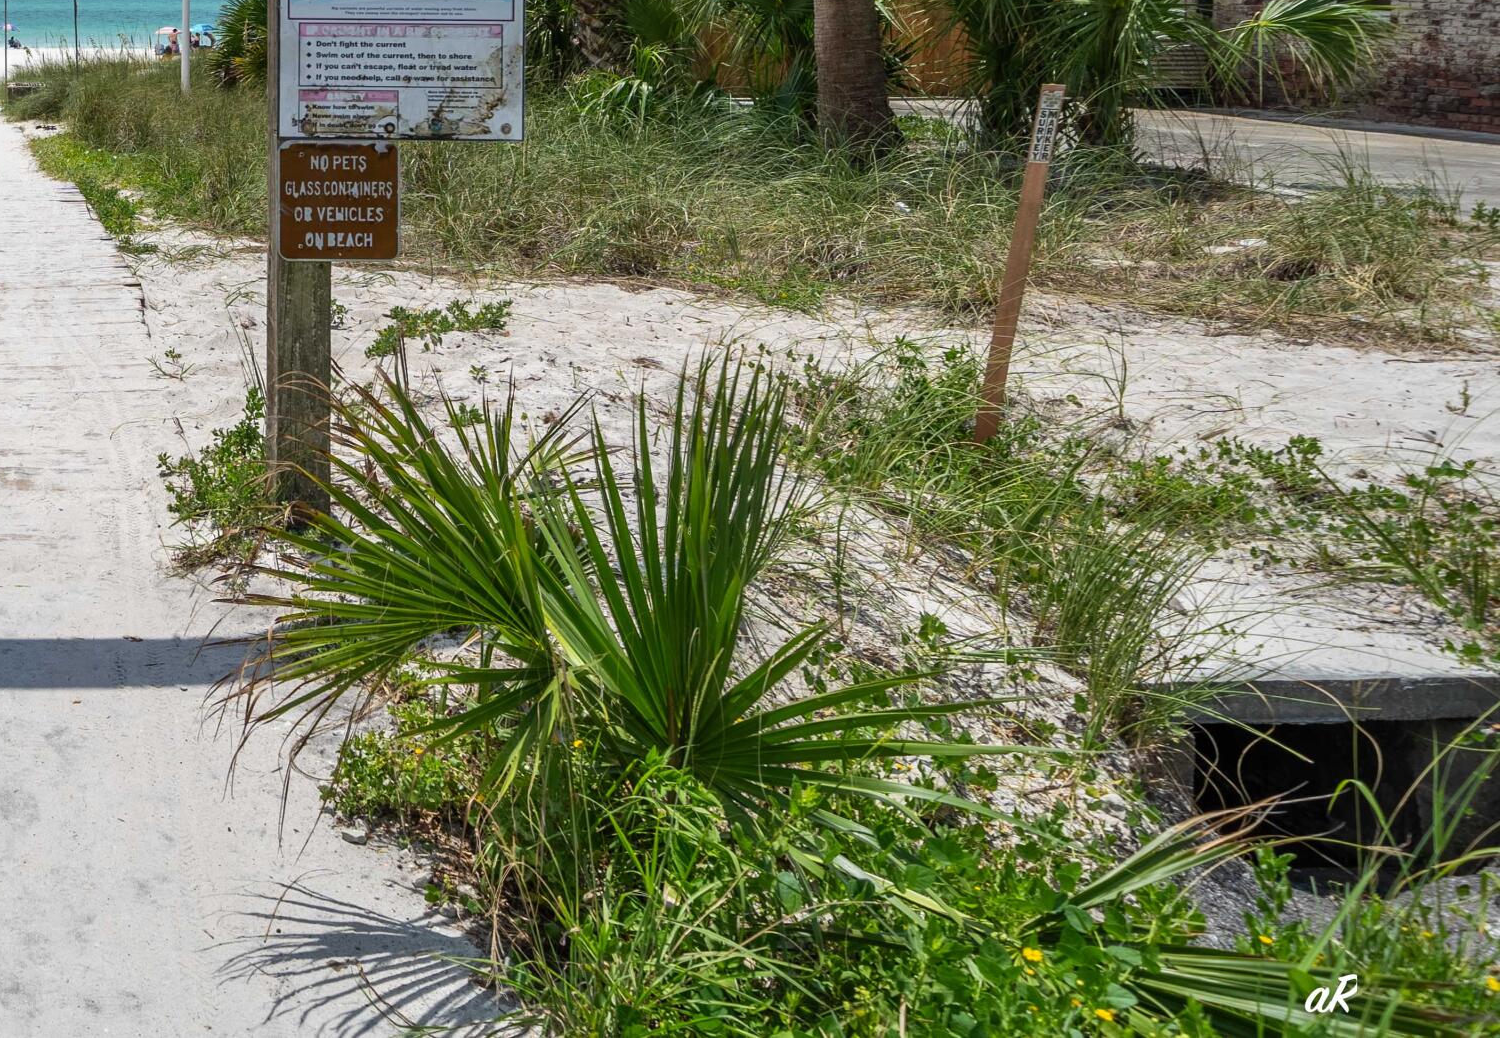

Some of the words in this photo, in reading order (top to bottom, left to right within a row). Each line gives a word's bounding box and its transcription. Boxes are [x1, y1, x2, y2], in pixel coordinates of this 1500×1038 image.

[339, 41, 358, 49] fight
[382, 52, 415, 60] current,
[449, 52, 472, 60] shore
[363, 64, 396, 72] escape,
[398, 63, 416, 71] float
[1033, 111, 1046, 160] SURVEY
[310, 155, 329, 172] NO
[332, 155, 367, 172] PETS
[285, 181, 321, 198] GLASS
[323, 181, 393, 199] CONTAINERS
[294, 206, 312, 222] OR
[317, 206, 384, 222] VEHICLES
[305, 231, 324, 250] ON
[327, 232, 373, 247] BEACH
